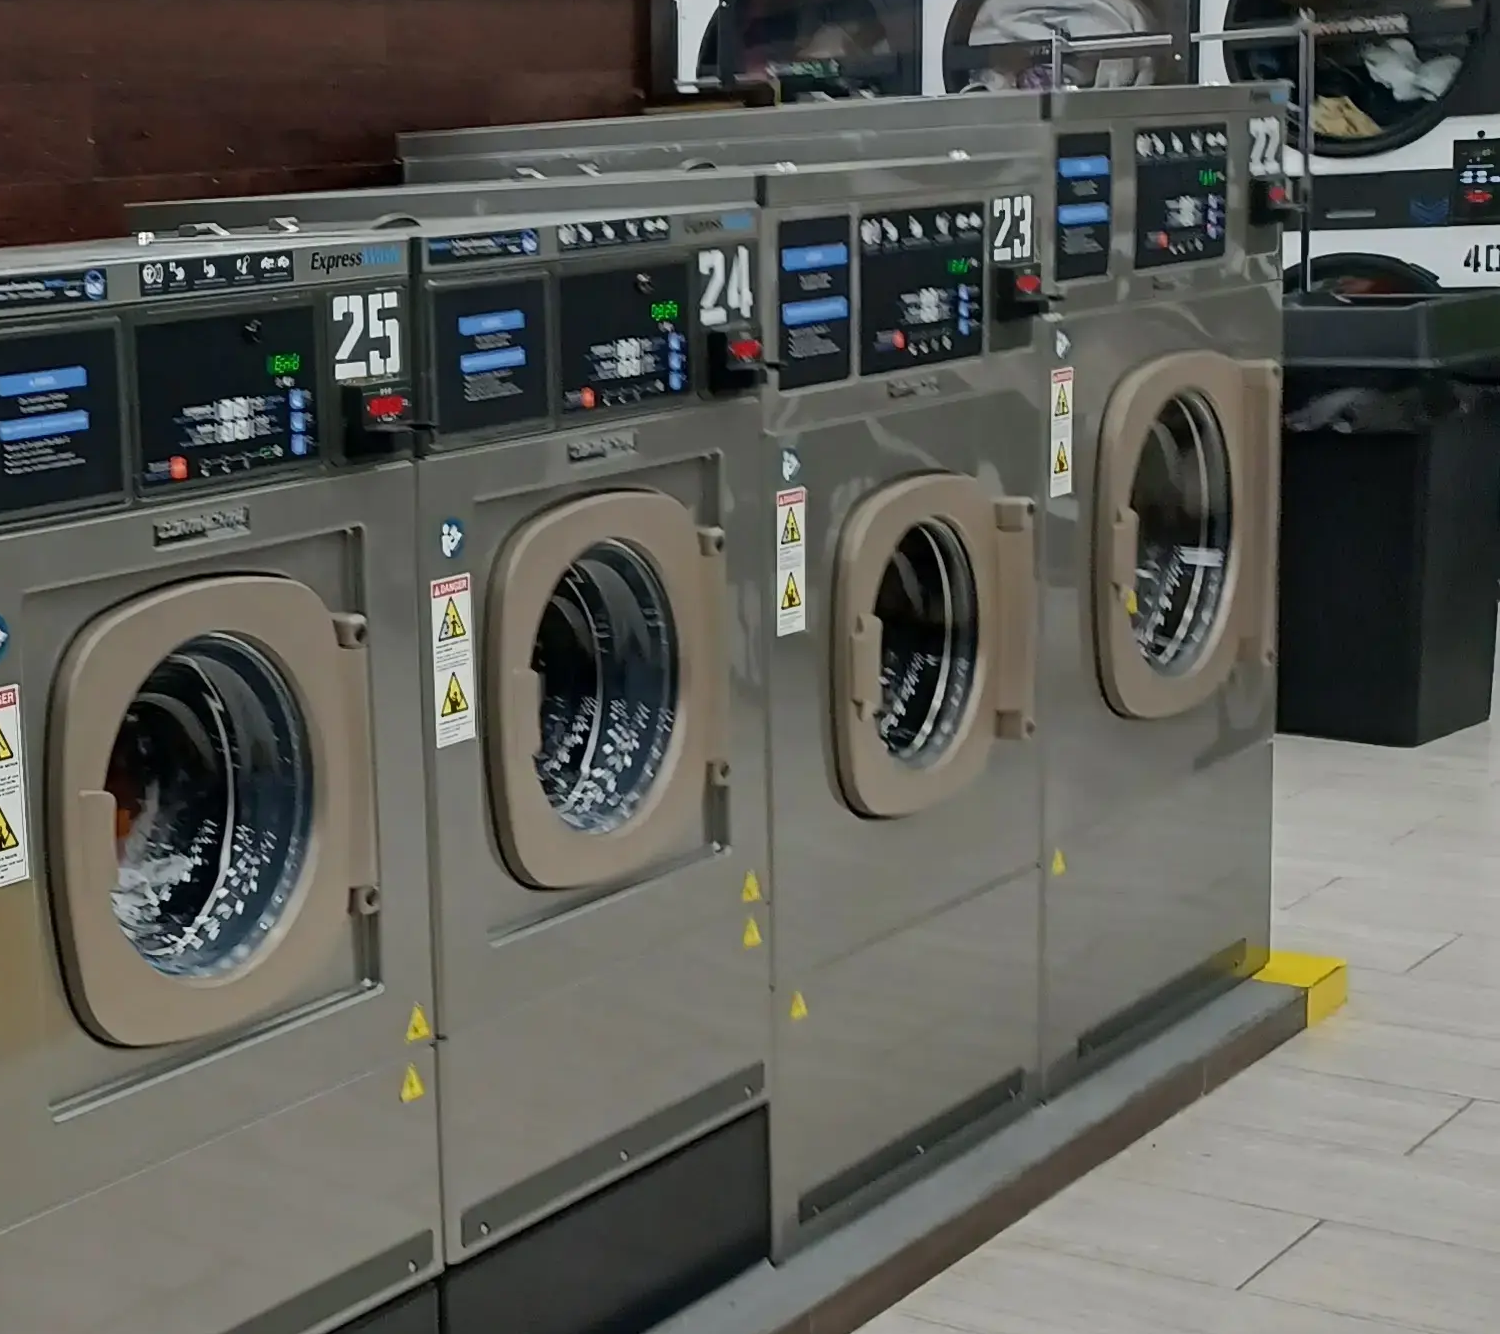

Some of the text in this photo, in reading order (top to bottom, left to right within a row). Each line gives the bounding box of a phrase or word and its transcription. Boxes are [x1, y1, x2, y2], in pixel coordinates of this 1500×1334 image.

[993, 195, 1032, 262] 23
[698, 245, 754, 326] 24
[332, 291, 400, 380] 25
